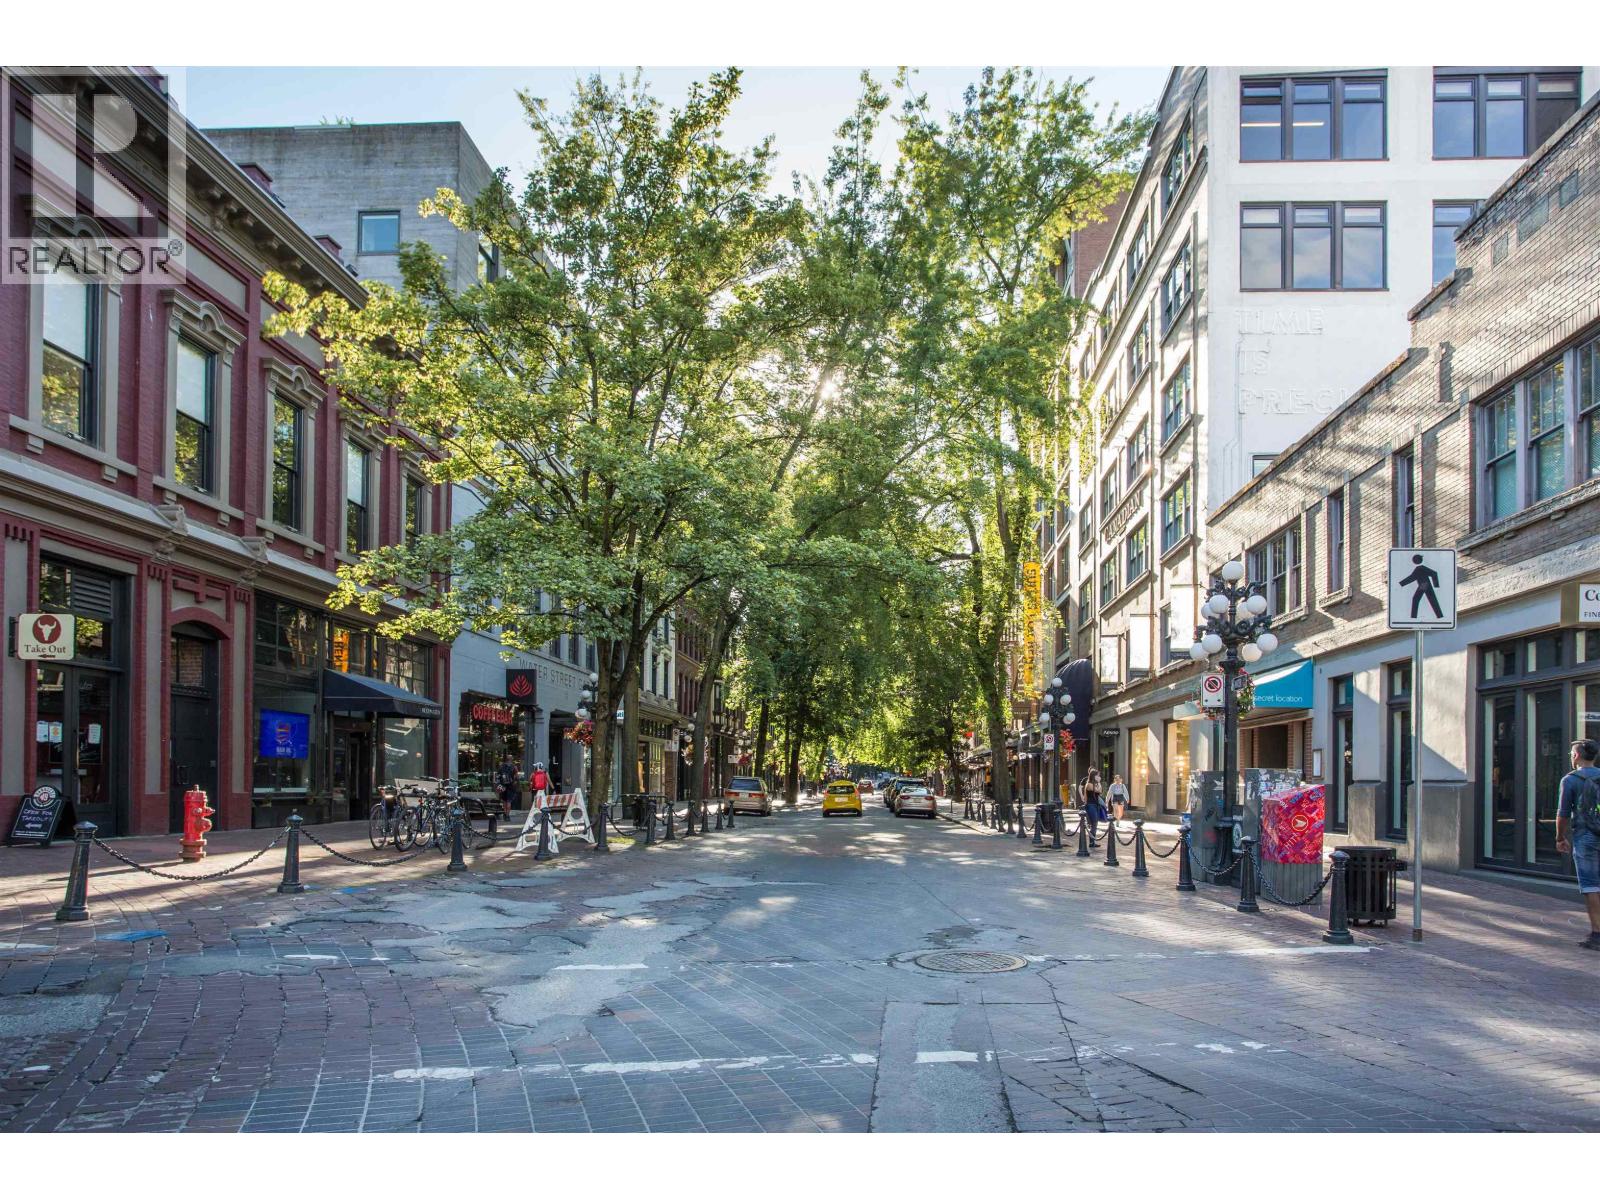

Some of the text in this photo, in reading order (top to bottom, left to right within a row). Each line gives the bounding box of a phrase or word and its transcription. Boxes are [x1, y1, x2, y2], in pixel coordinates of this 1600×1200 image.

[1238, 308, 1323, 335] TIME
[1241, 349, 1270, 375] IS
[24, 644, 66, 653] Take Out
[550, 669, 576, 689] STREET
[1276, 694, 1303, 703] location
